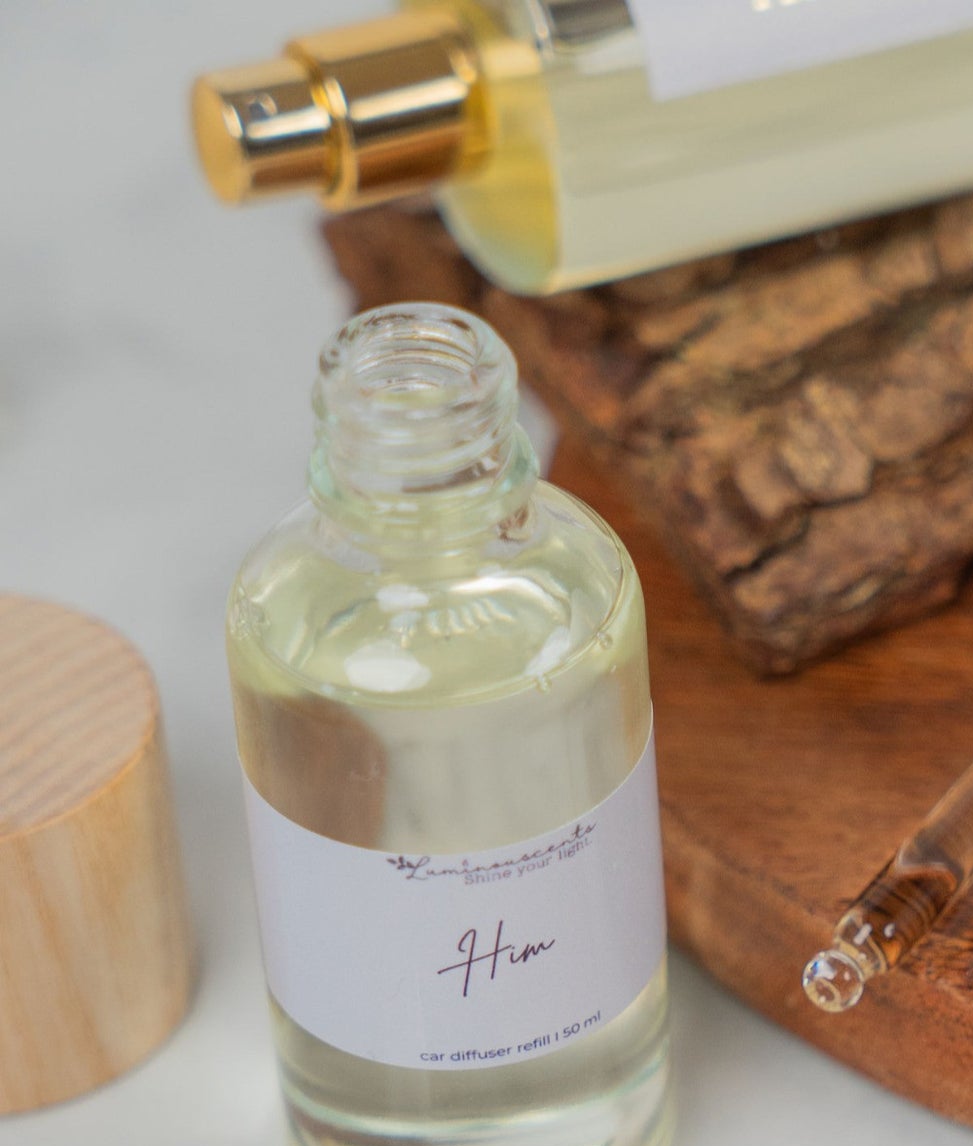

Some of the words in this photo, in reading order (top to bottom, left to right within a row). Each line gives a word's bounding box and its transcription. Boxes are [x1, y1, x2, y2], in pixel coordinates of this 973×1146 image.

[463, 868, 512, 886] Shine
[517, 854, 552, 877] your
[437, 920, 556, 998] Him
[419, 1052, 446, 1062] car
[449, 1046, 513, 1062] diffuser
[516, 1033, 551, 1054] refill
[562, 1022, 582, 1039] 50
[583, 1010, 602, 1029] ml
